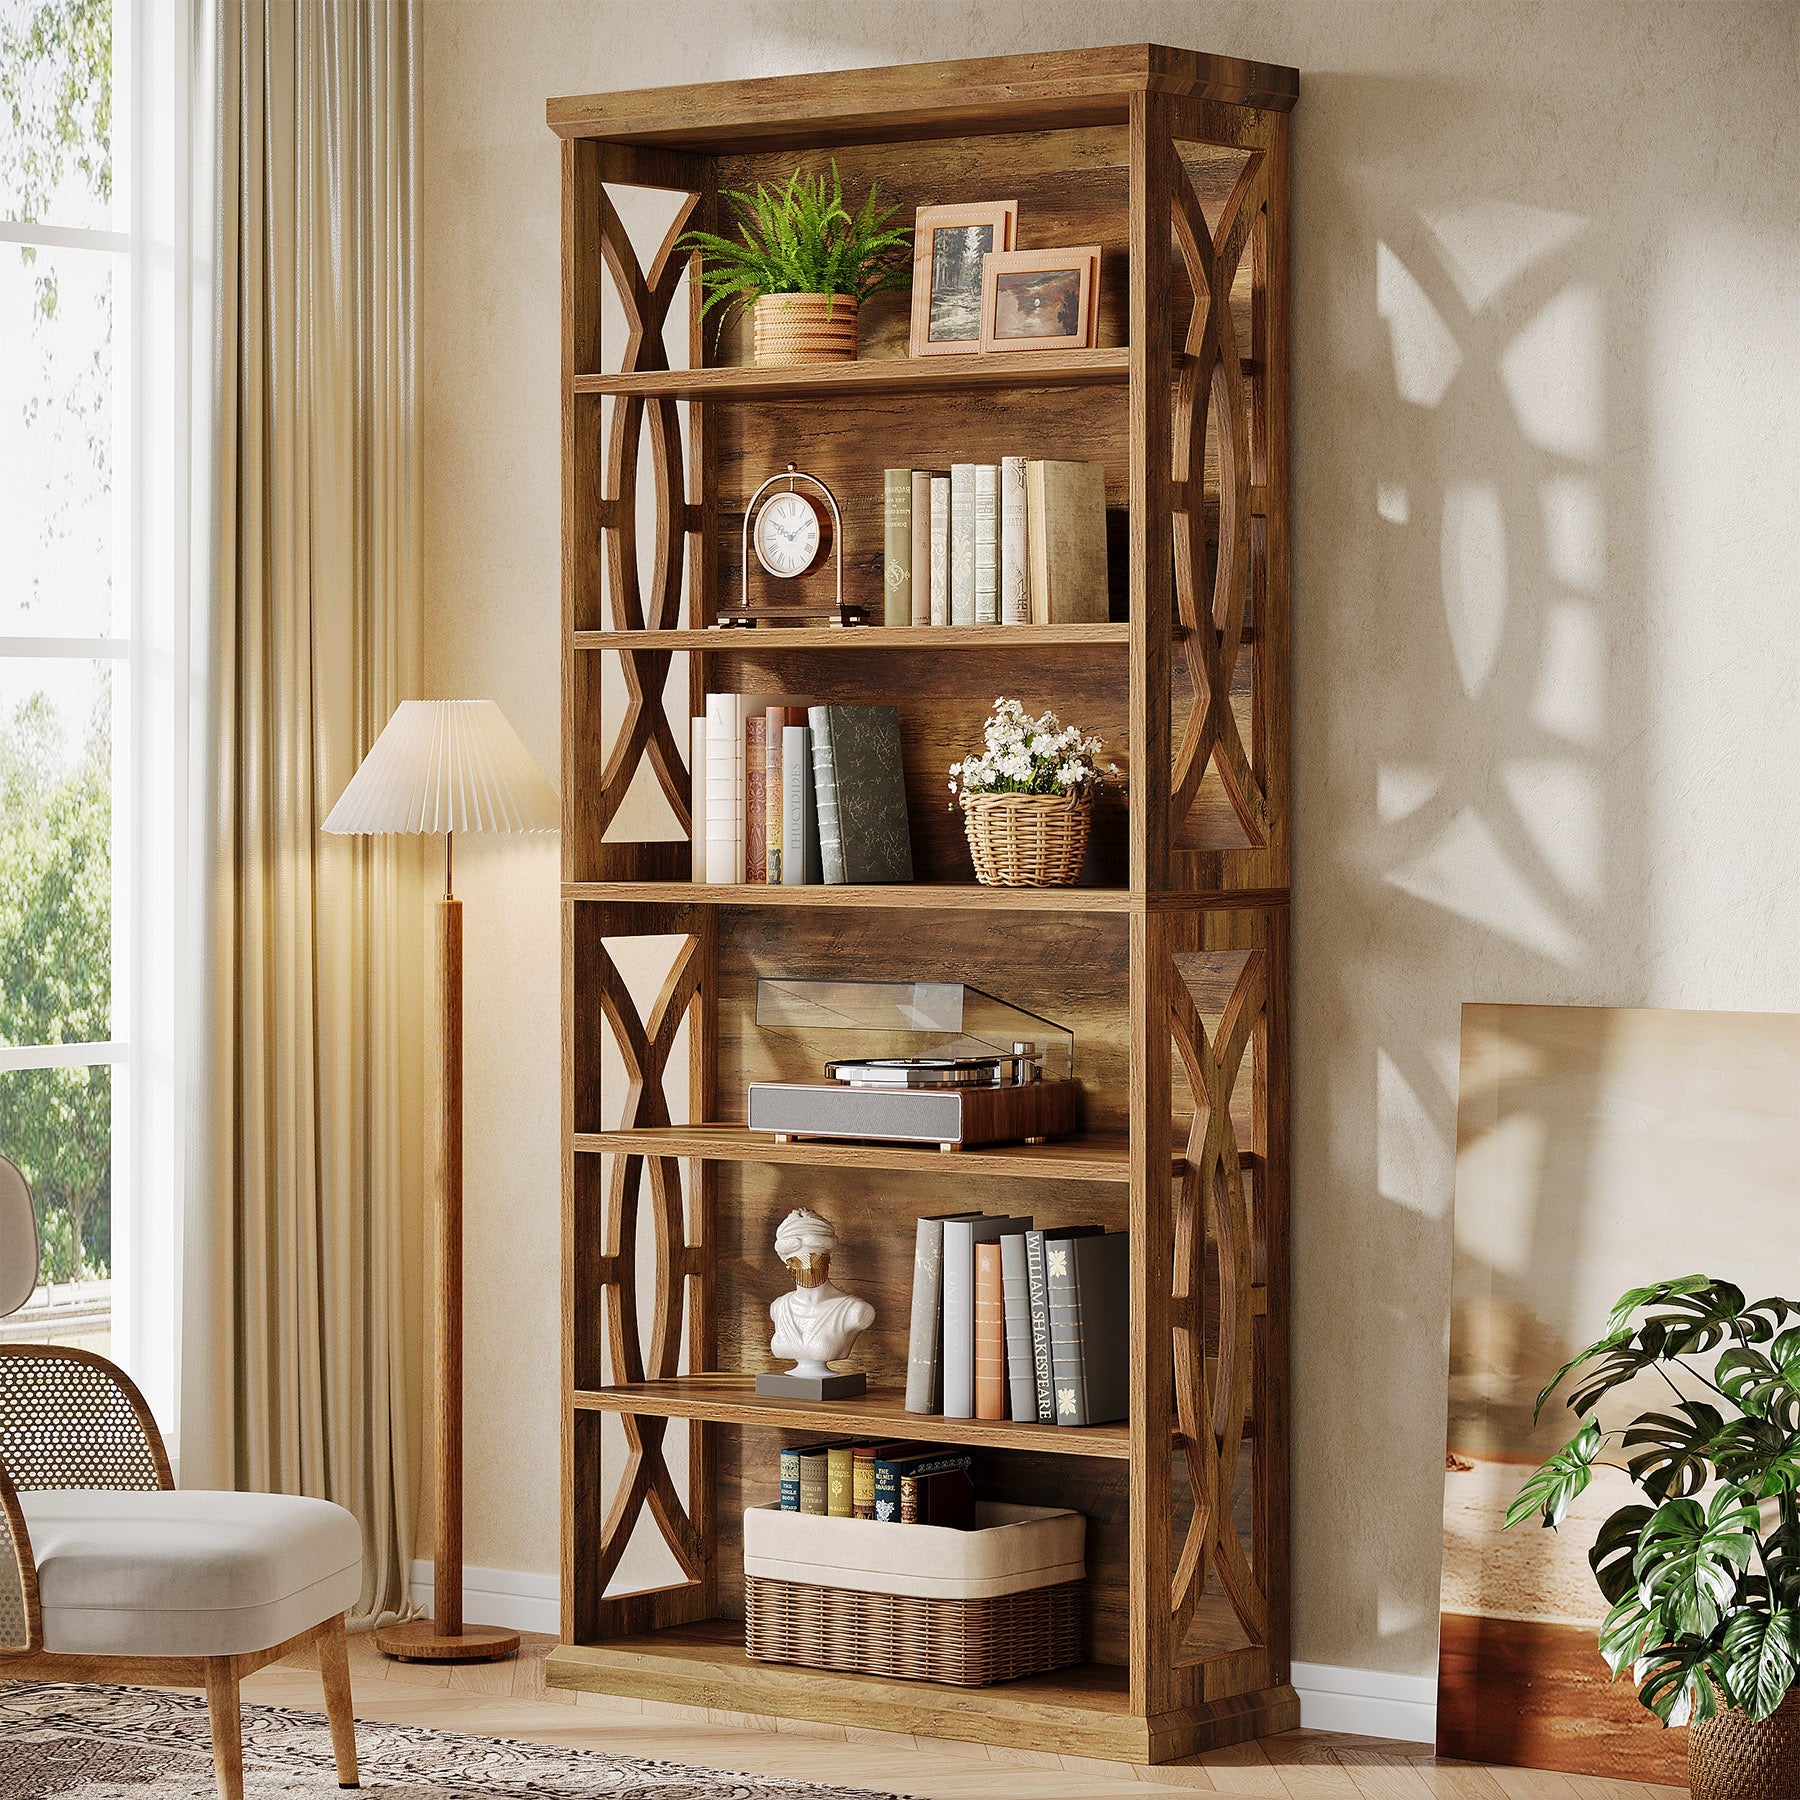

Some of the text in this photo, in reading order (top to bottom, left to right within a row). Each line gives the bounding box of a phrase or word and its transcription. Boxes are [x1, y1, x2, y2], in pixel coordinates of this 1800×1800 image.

[791, 763, 801, 852] THUCYDIDES
[1028, 1234, 1052, 1420] WILLIAM SHAKESPEARE
